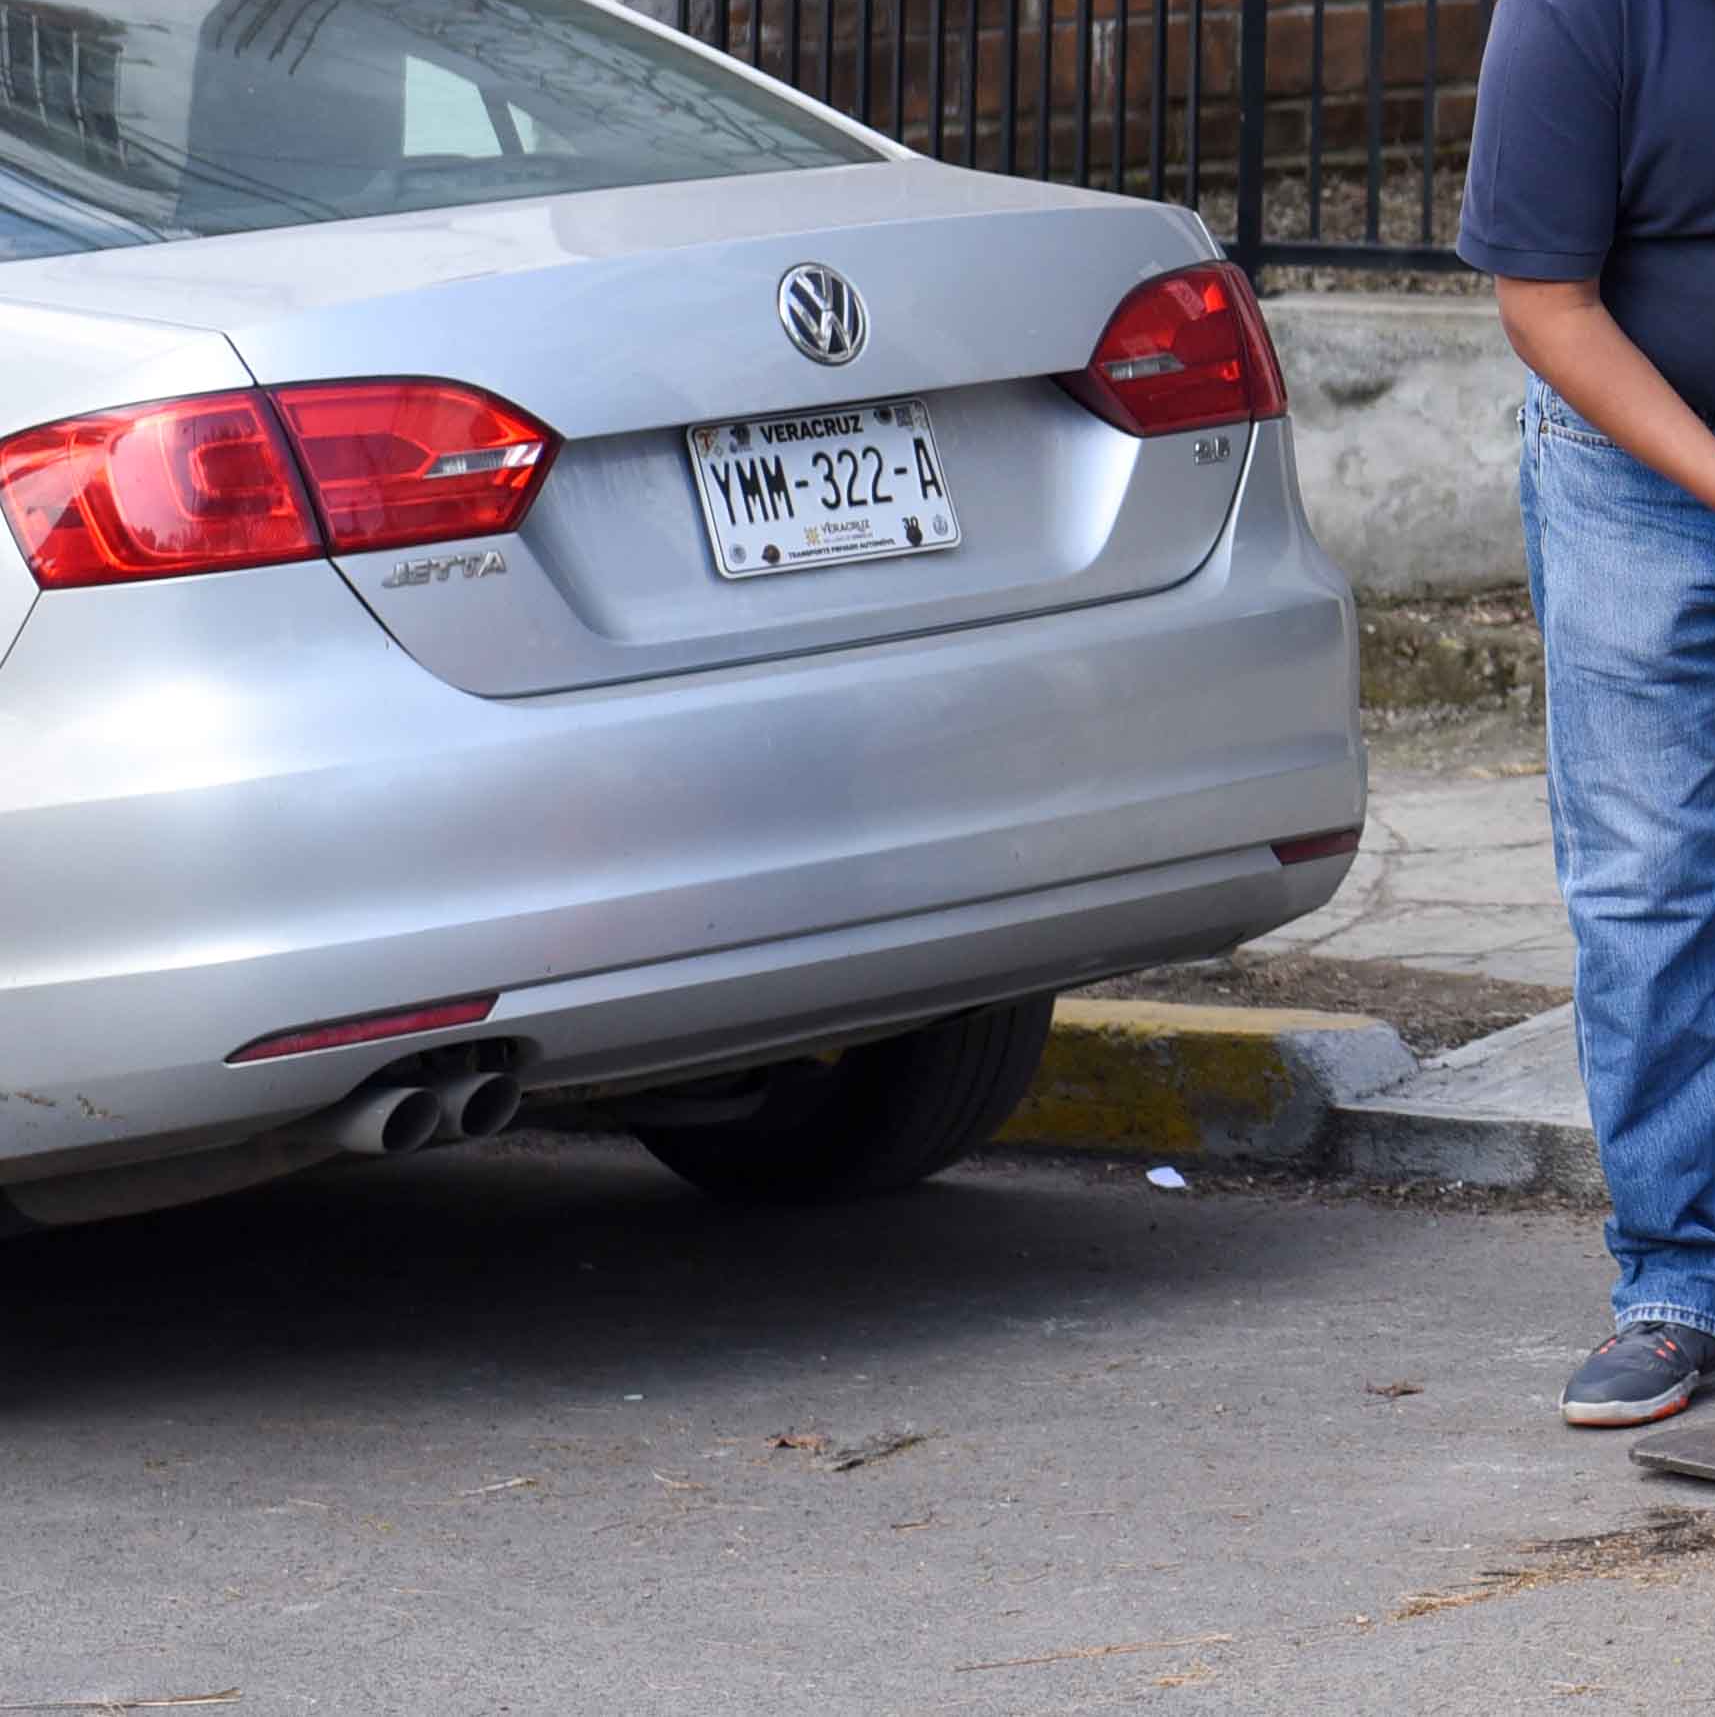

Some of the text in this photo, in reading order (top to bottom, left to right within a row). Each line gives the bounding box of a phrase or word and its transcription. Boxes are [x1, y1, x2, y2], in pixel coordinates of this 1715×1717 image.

[759, 414, 864, 444] VERACRUZ
[710, 435, 943, 526] YMM-322-A
[382, 550, 507, 588] JETTA
